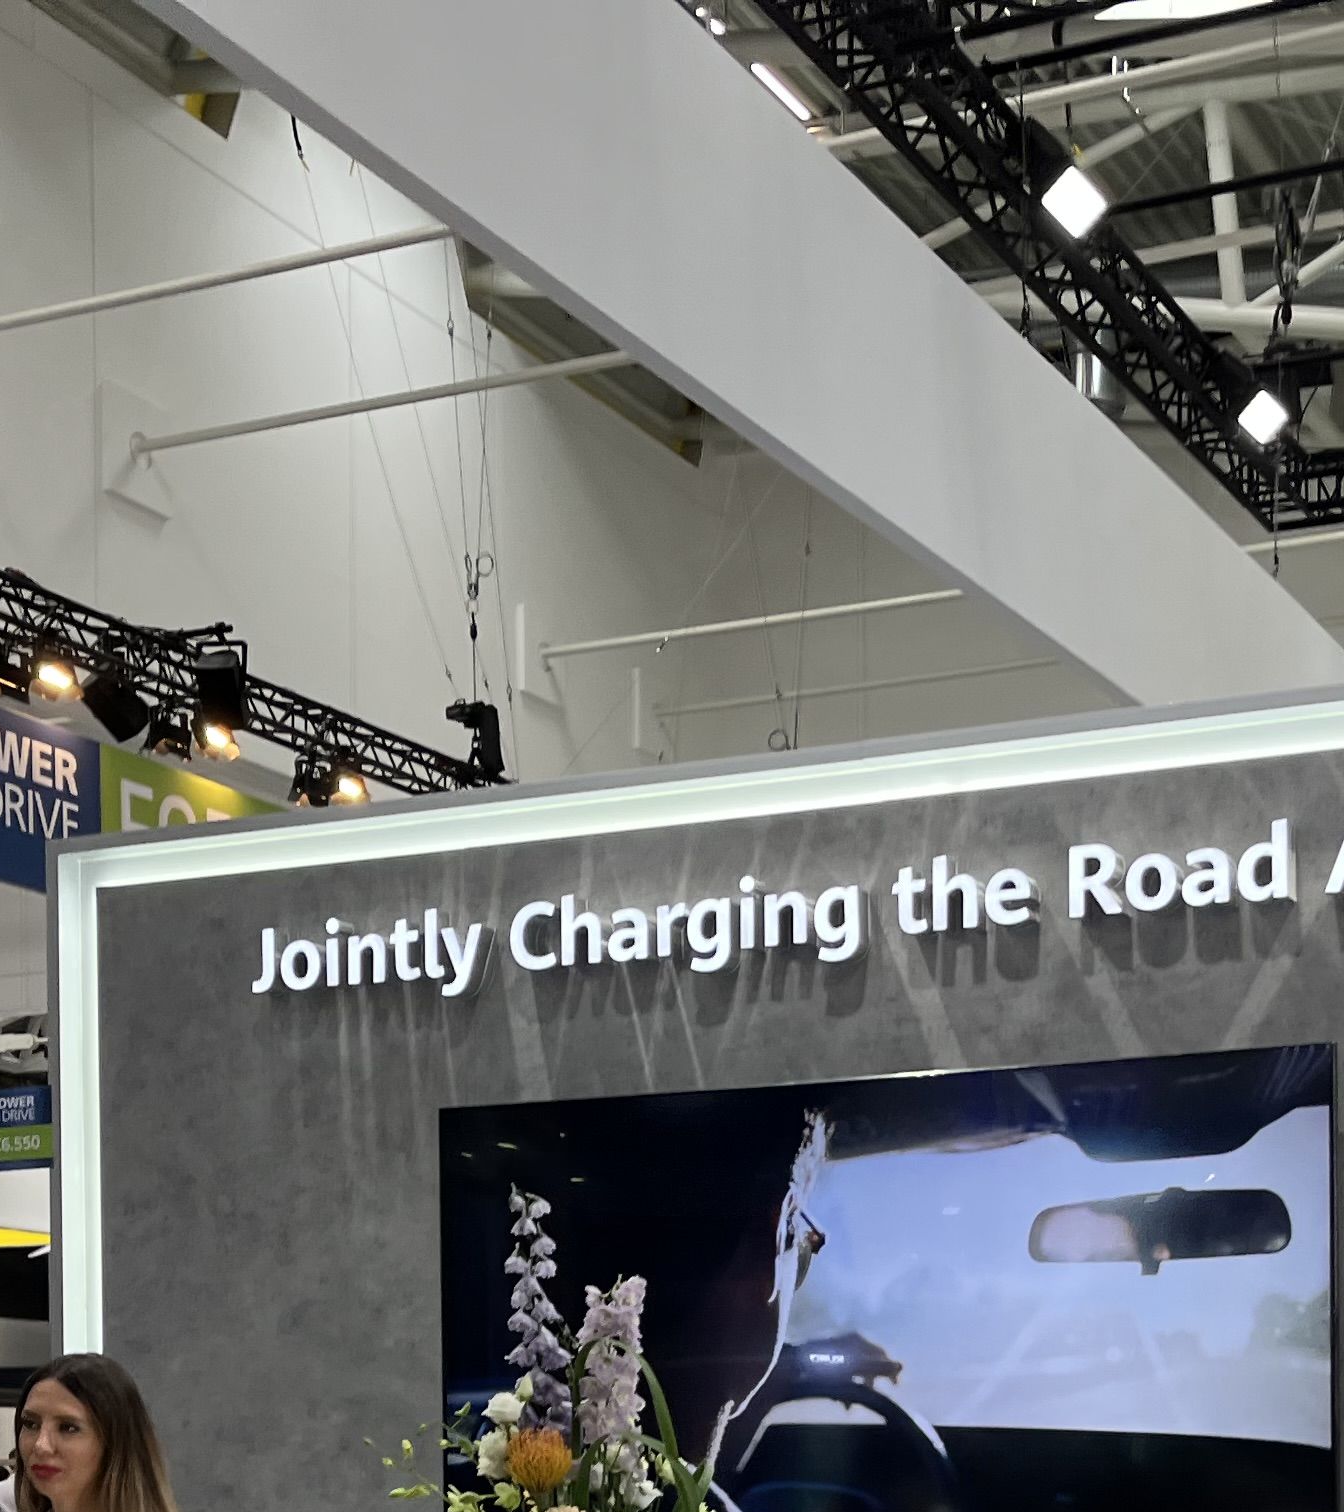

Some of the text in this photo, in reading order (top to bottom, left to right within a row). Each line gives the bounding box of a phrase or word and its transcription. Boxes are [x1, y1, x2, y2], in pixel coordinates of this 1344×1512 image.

[251, 908, 484, 997] Jointly
[509, 875, 861, 974] Charging
[891, 855, 1036, 934] the
[1068, 819, 1296, 919] Road
[2, 1107, 35, 1122] DRIVE
